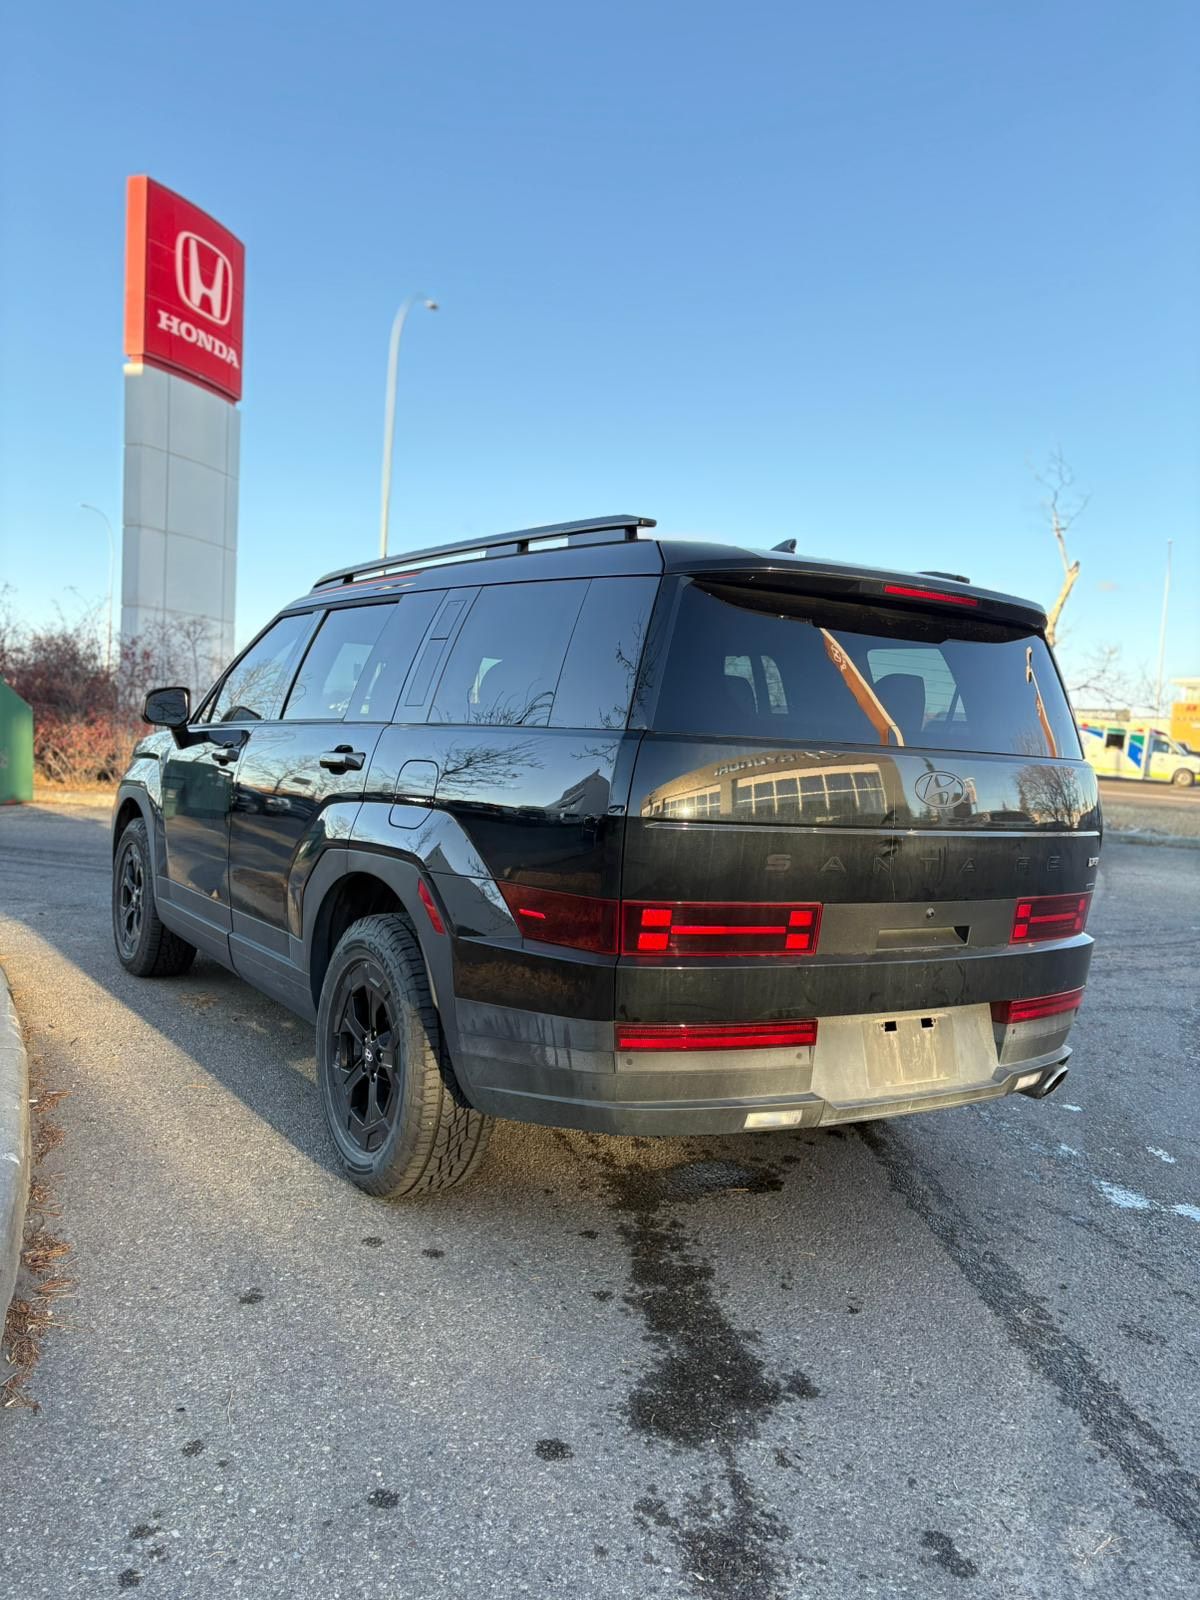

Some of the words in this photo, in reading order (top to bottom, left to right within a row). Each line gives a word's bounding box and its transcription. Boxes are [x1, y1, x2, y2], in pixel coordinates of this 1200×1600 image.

[157, 308, 240, 369] HONDA
[765, 854, 976, 873] SANTA
[1015, 855, 1065, 873] FE
